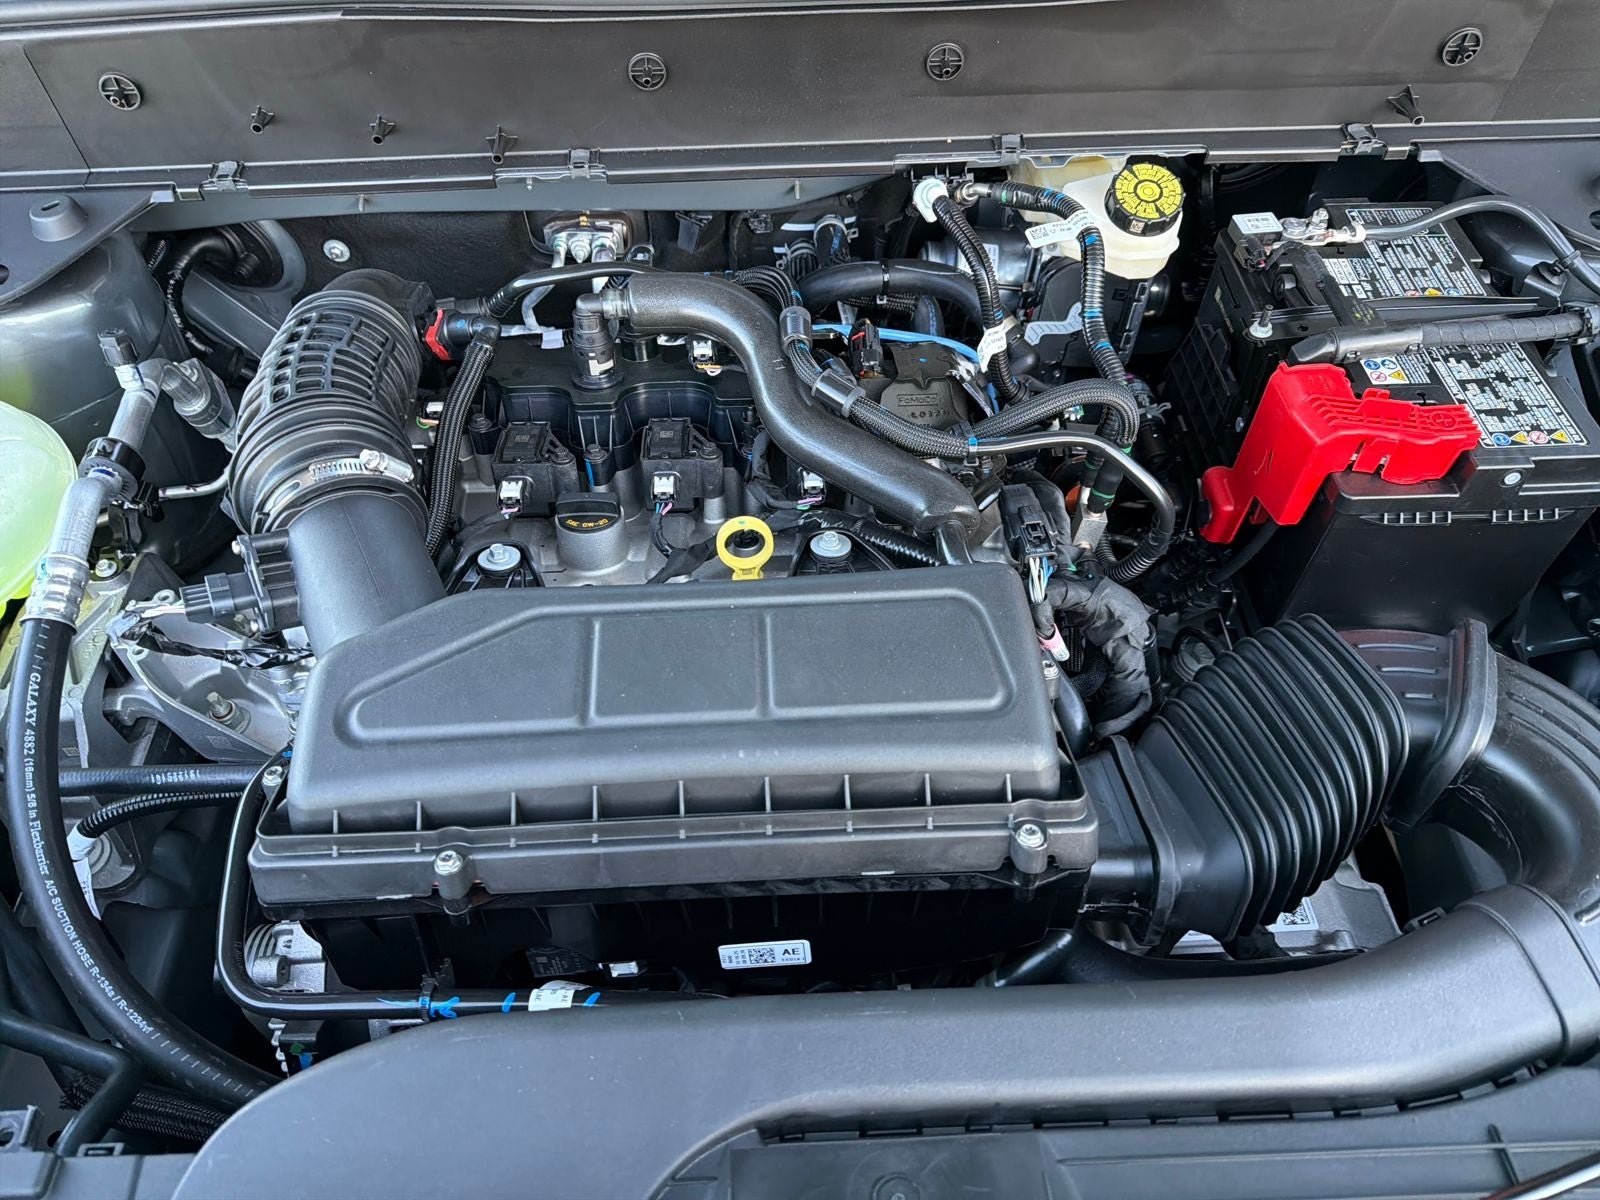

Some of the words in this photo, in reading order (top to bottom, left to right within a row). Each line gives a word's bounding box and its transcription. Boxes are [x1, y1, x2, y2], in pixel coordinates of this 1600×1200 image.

[898, 395, 937, 404] FoMoCo
[566, 519, 580, 527] SAE
[25, 673, 41, 726] GALAXY
[24, 728, 36, 755] 4882
[27, 793, 37, 808] 5/8
[28, 809, 38, 819] in
[29, 820, 50, 876] Flexbarrier
[45, 879, 58, 897] A/C
[51, 897, 78, 941] SUCTION
[72, 939, 94, 968] HOSE
[782, 948, 801, 956] AE
[89, 964, 115, 998] R-134a
[117, 998, 155, 1035] R-1234yf
